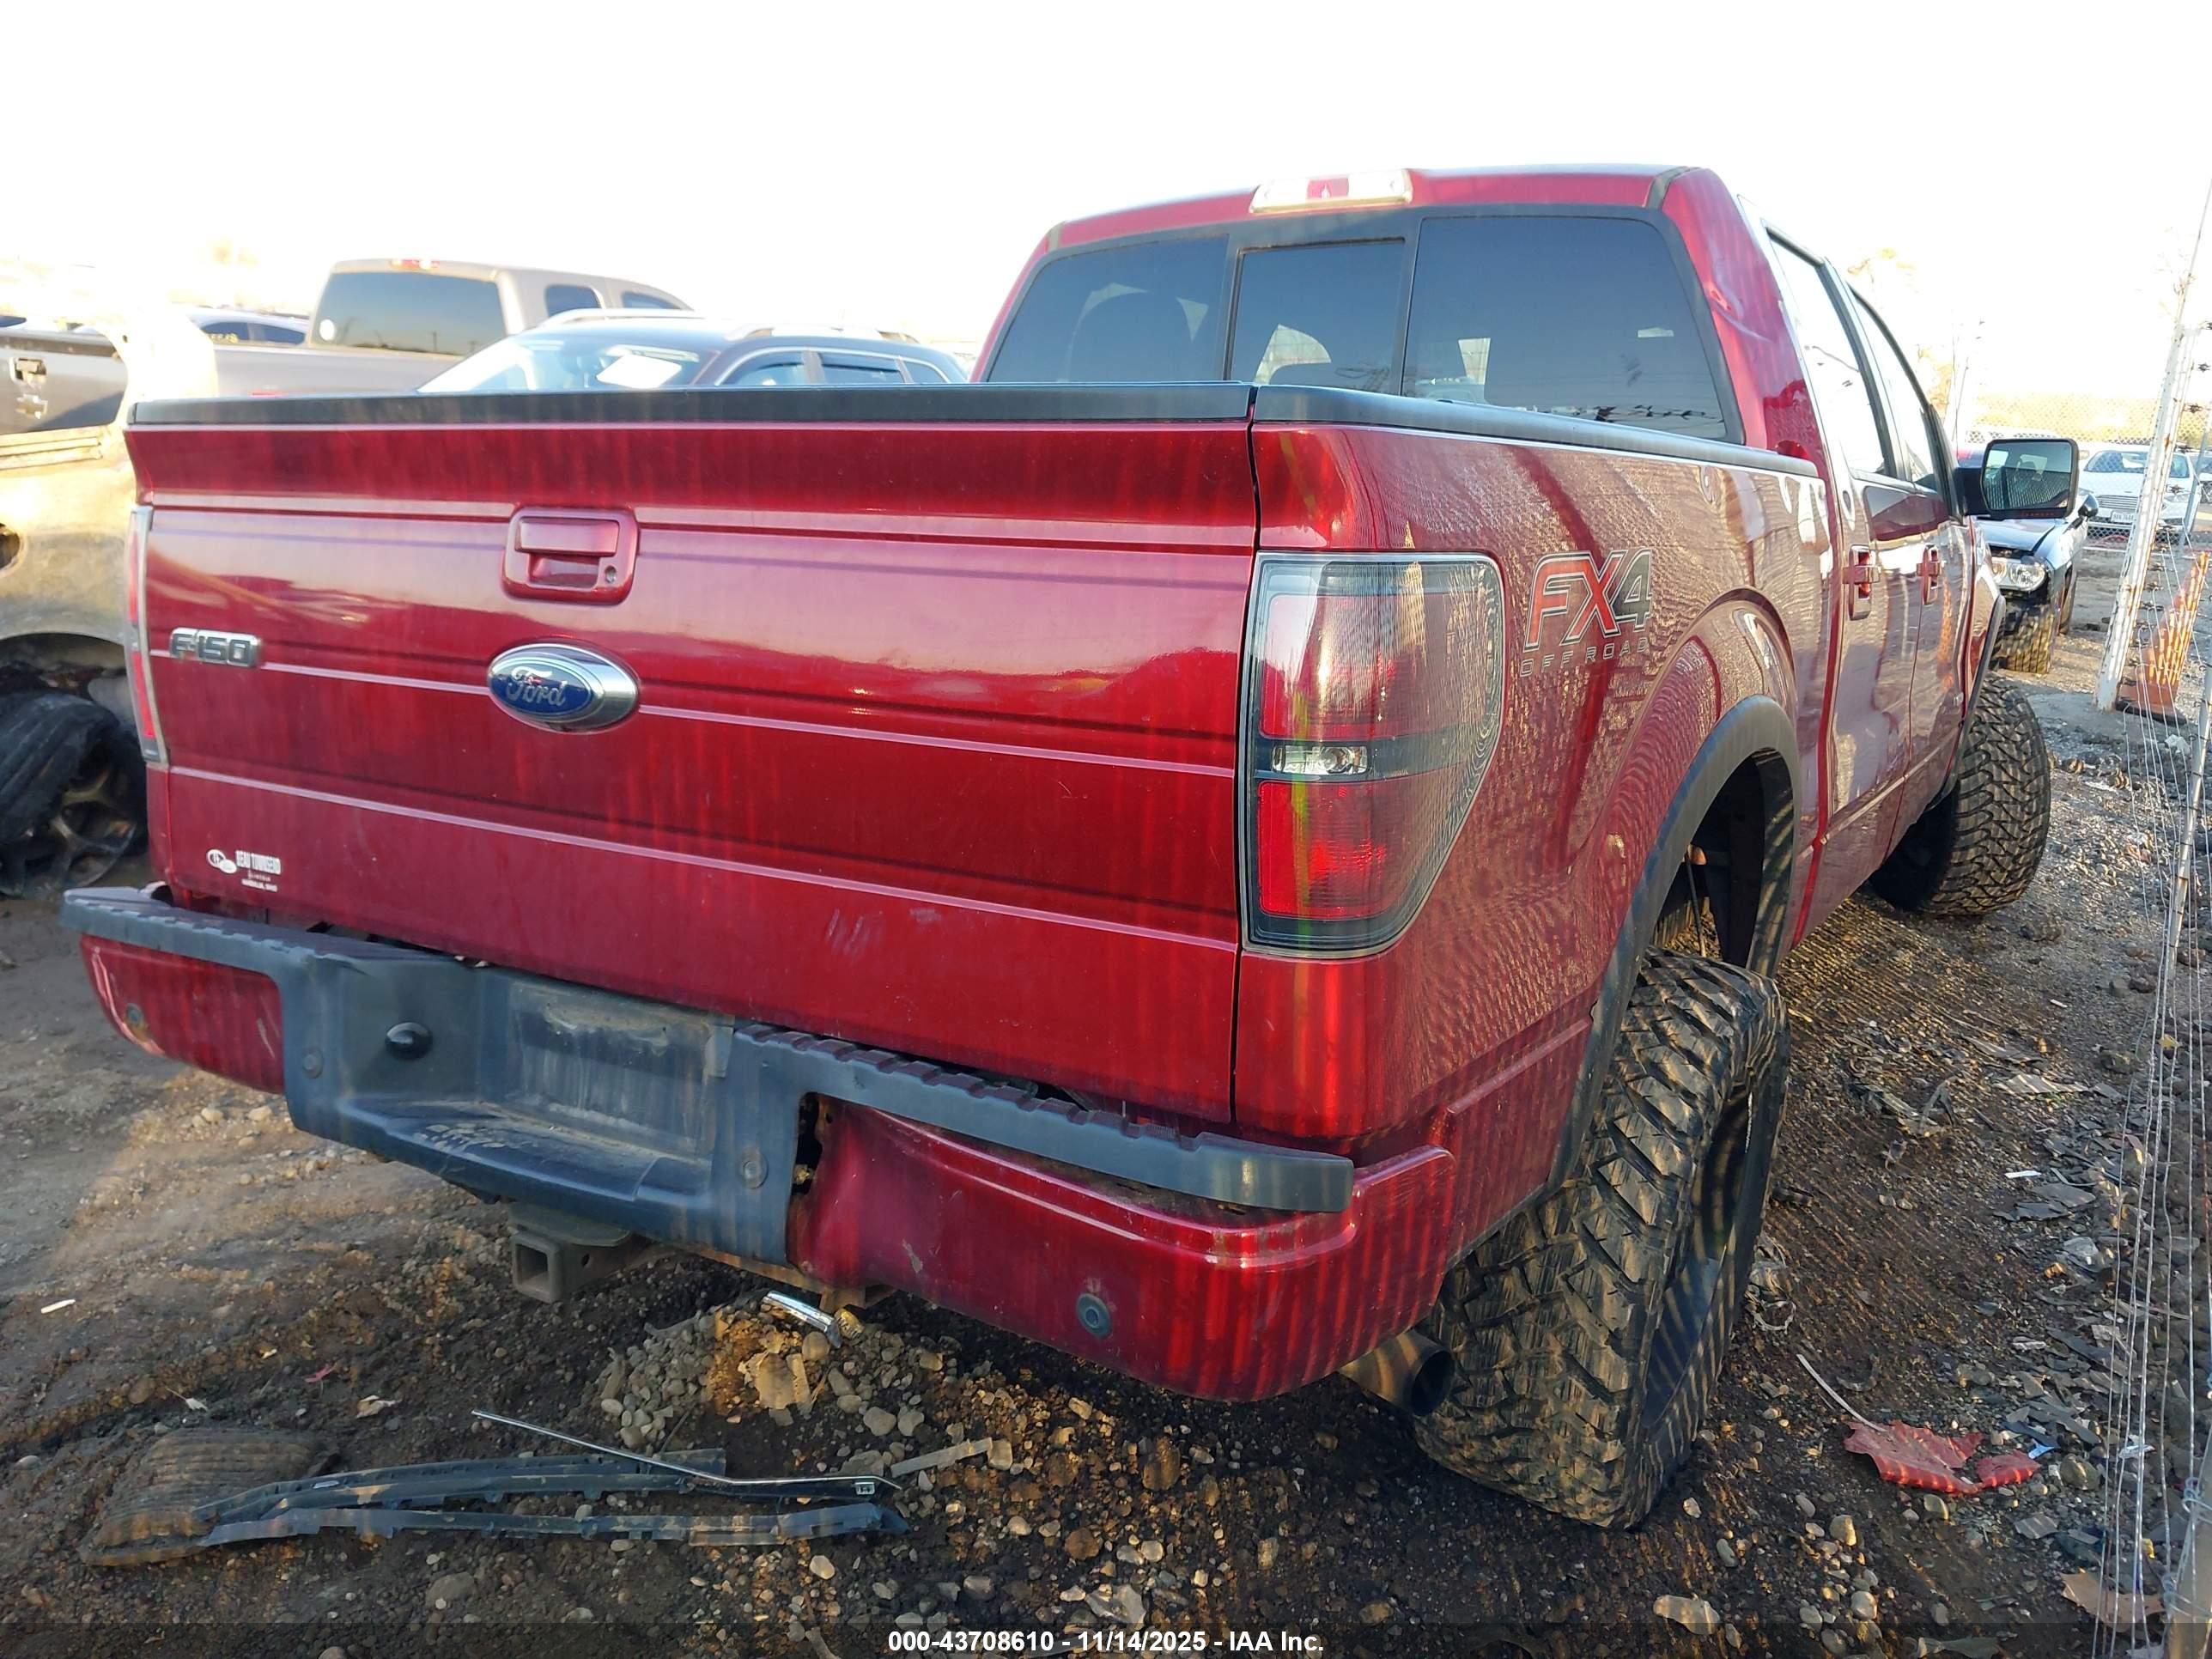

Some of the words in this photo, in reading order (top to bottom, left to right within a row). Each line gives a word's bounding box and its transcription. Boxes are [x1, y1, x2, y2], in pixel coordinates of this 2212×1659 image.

[1523, 549, 1652, 653] FX4
[1521, 651, 1574, 678] OFF
[1586, 638, 1650, 662] ROAD
[506, 665, 568, 707] Ford
